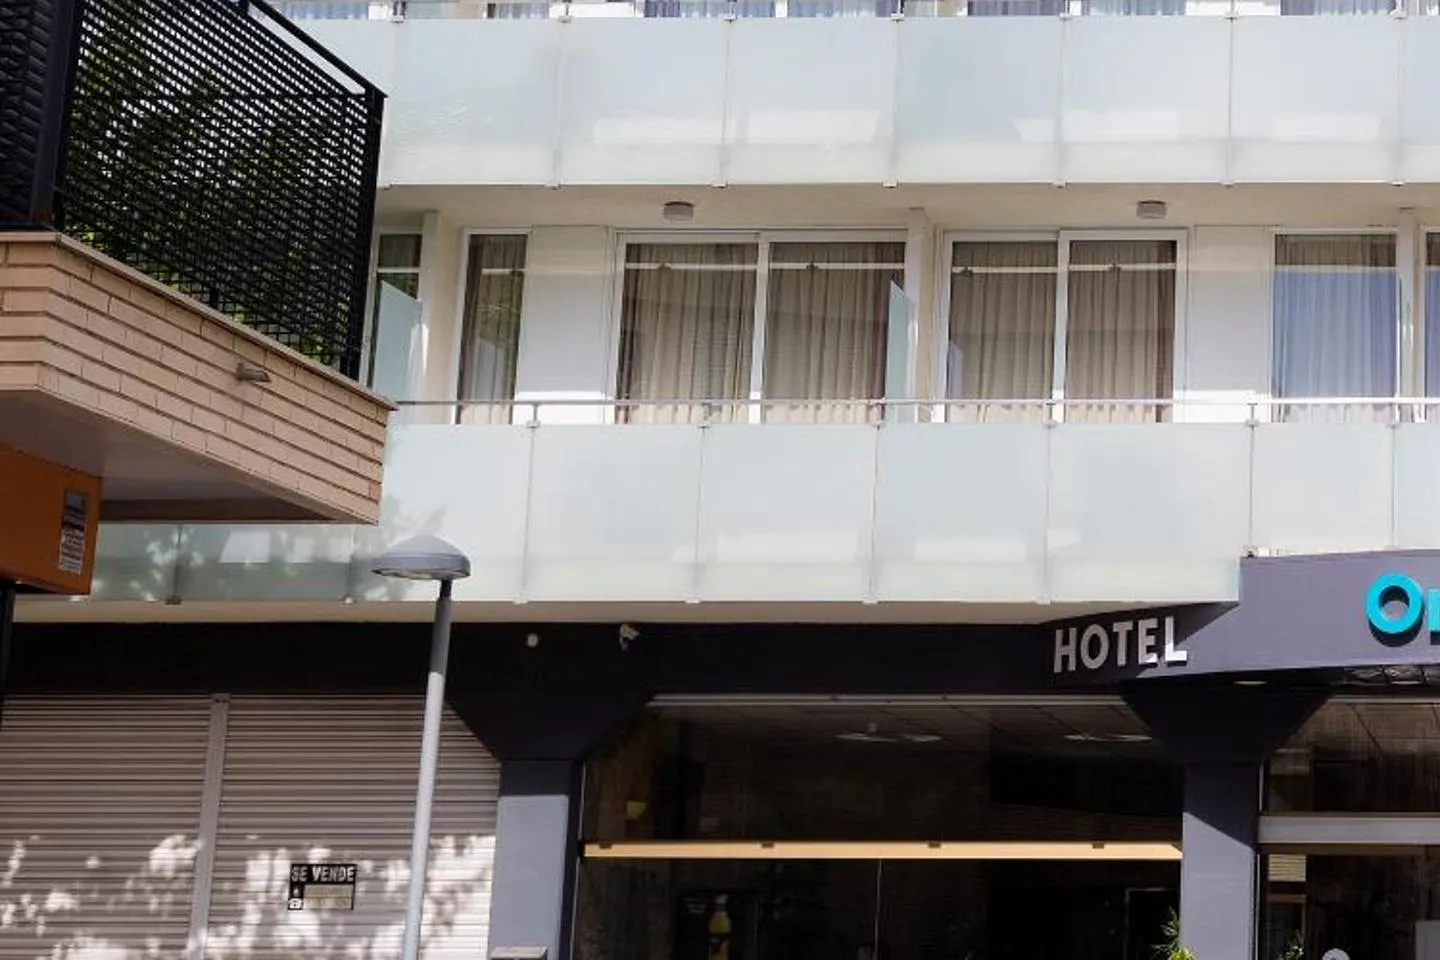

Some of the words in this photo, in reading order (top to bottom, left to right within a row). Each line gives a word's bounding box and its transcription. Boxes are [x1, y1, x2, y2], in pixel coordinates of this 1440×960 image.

[1053, 616, 1187, 673] HOTEL
[291, 865, 308, 882] SE
[312, 865, 354, 882] VENDE
